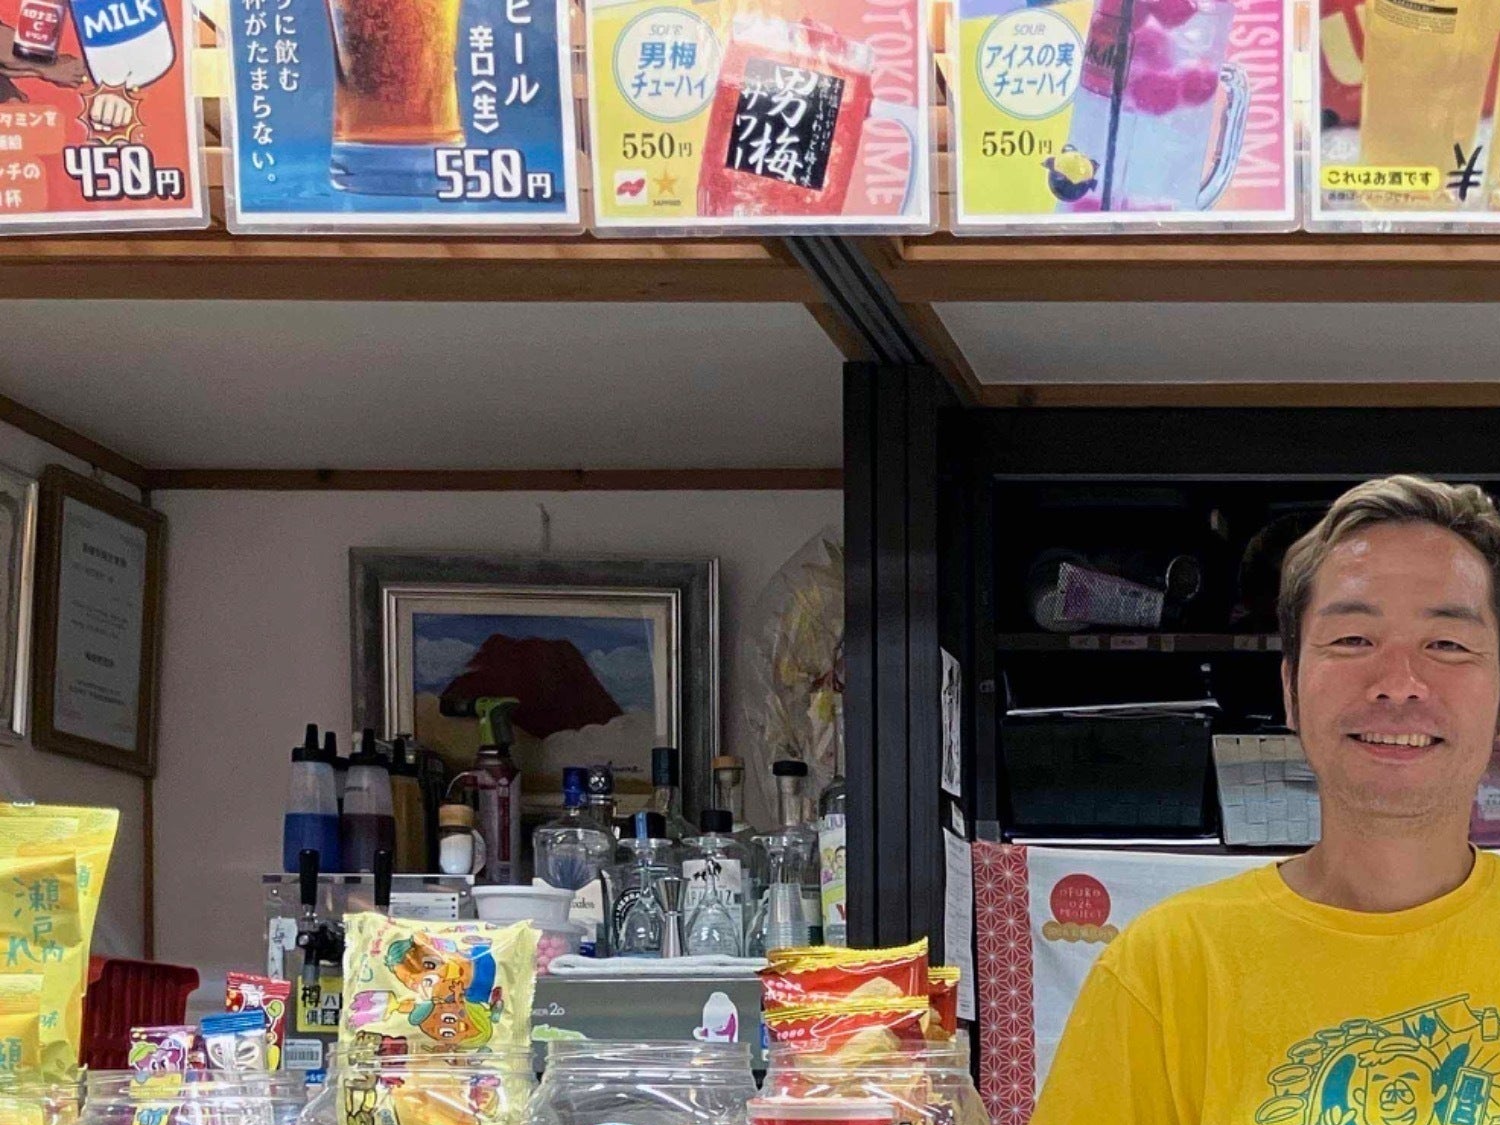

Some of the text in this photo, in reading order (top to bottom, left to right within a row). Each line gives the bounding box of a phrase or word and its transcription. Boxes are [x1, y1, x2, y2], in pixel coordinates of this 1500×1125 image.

[83, 0, 158, 39] MILK
[638, 41, 698, 70] 男梅
[985, 43, 1075, 69] アイスの実
[631, 74, 708, 99] チューハイ
[993, 73, 1071, 98] チューハイ
[749, 65, 819, 184] 男梅
[621, 131, 693, 160] 550円
[981, 130, 1053, 158] 550円
[65, 147, 182, 198] 450円
[435, 149, 552, 200] 550円
[1326, 169, 1433, 187] これはお酒です
